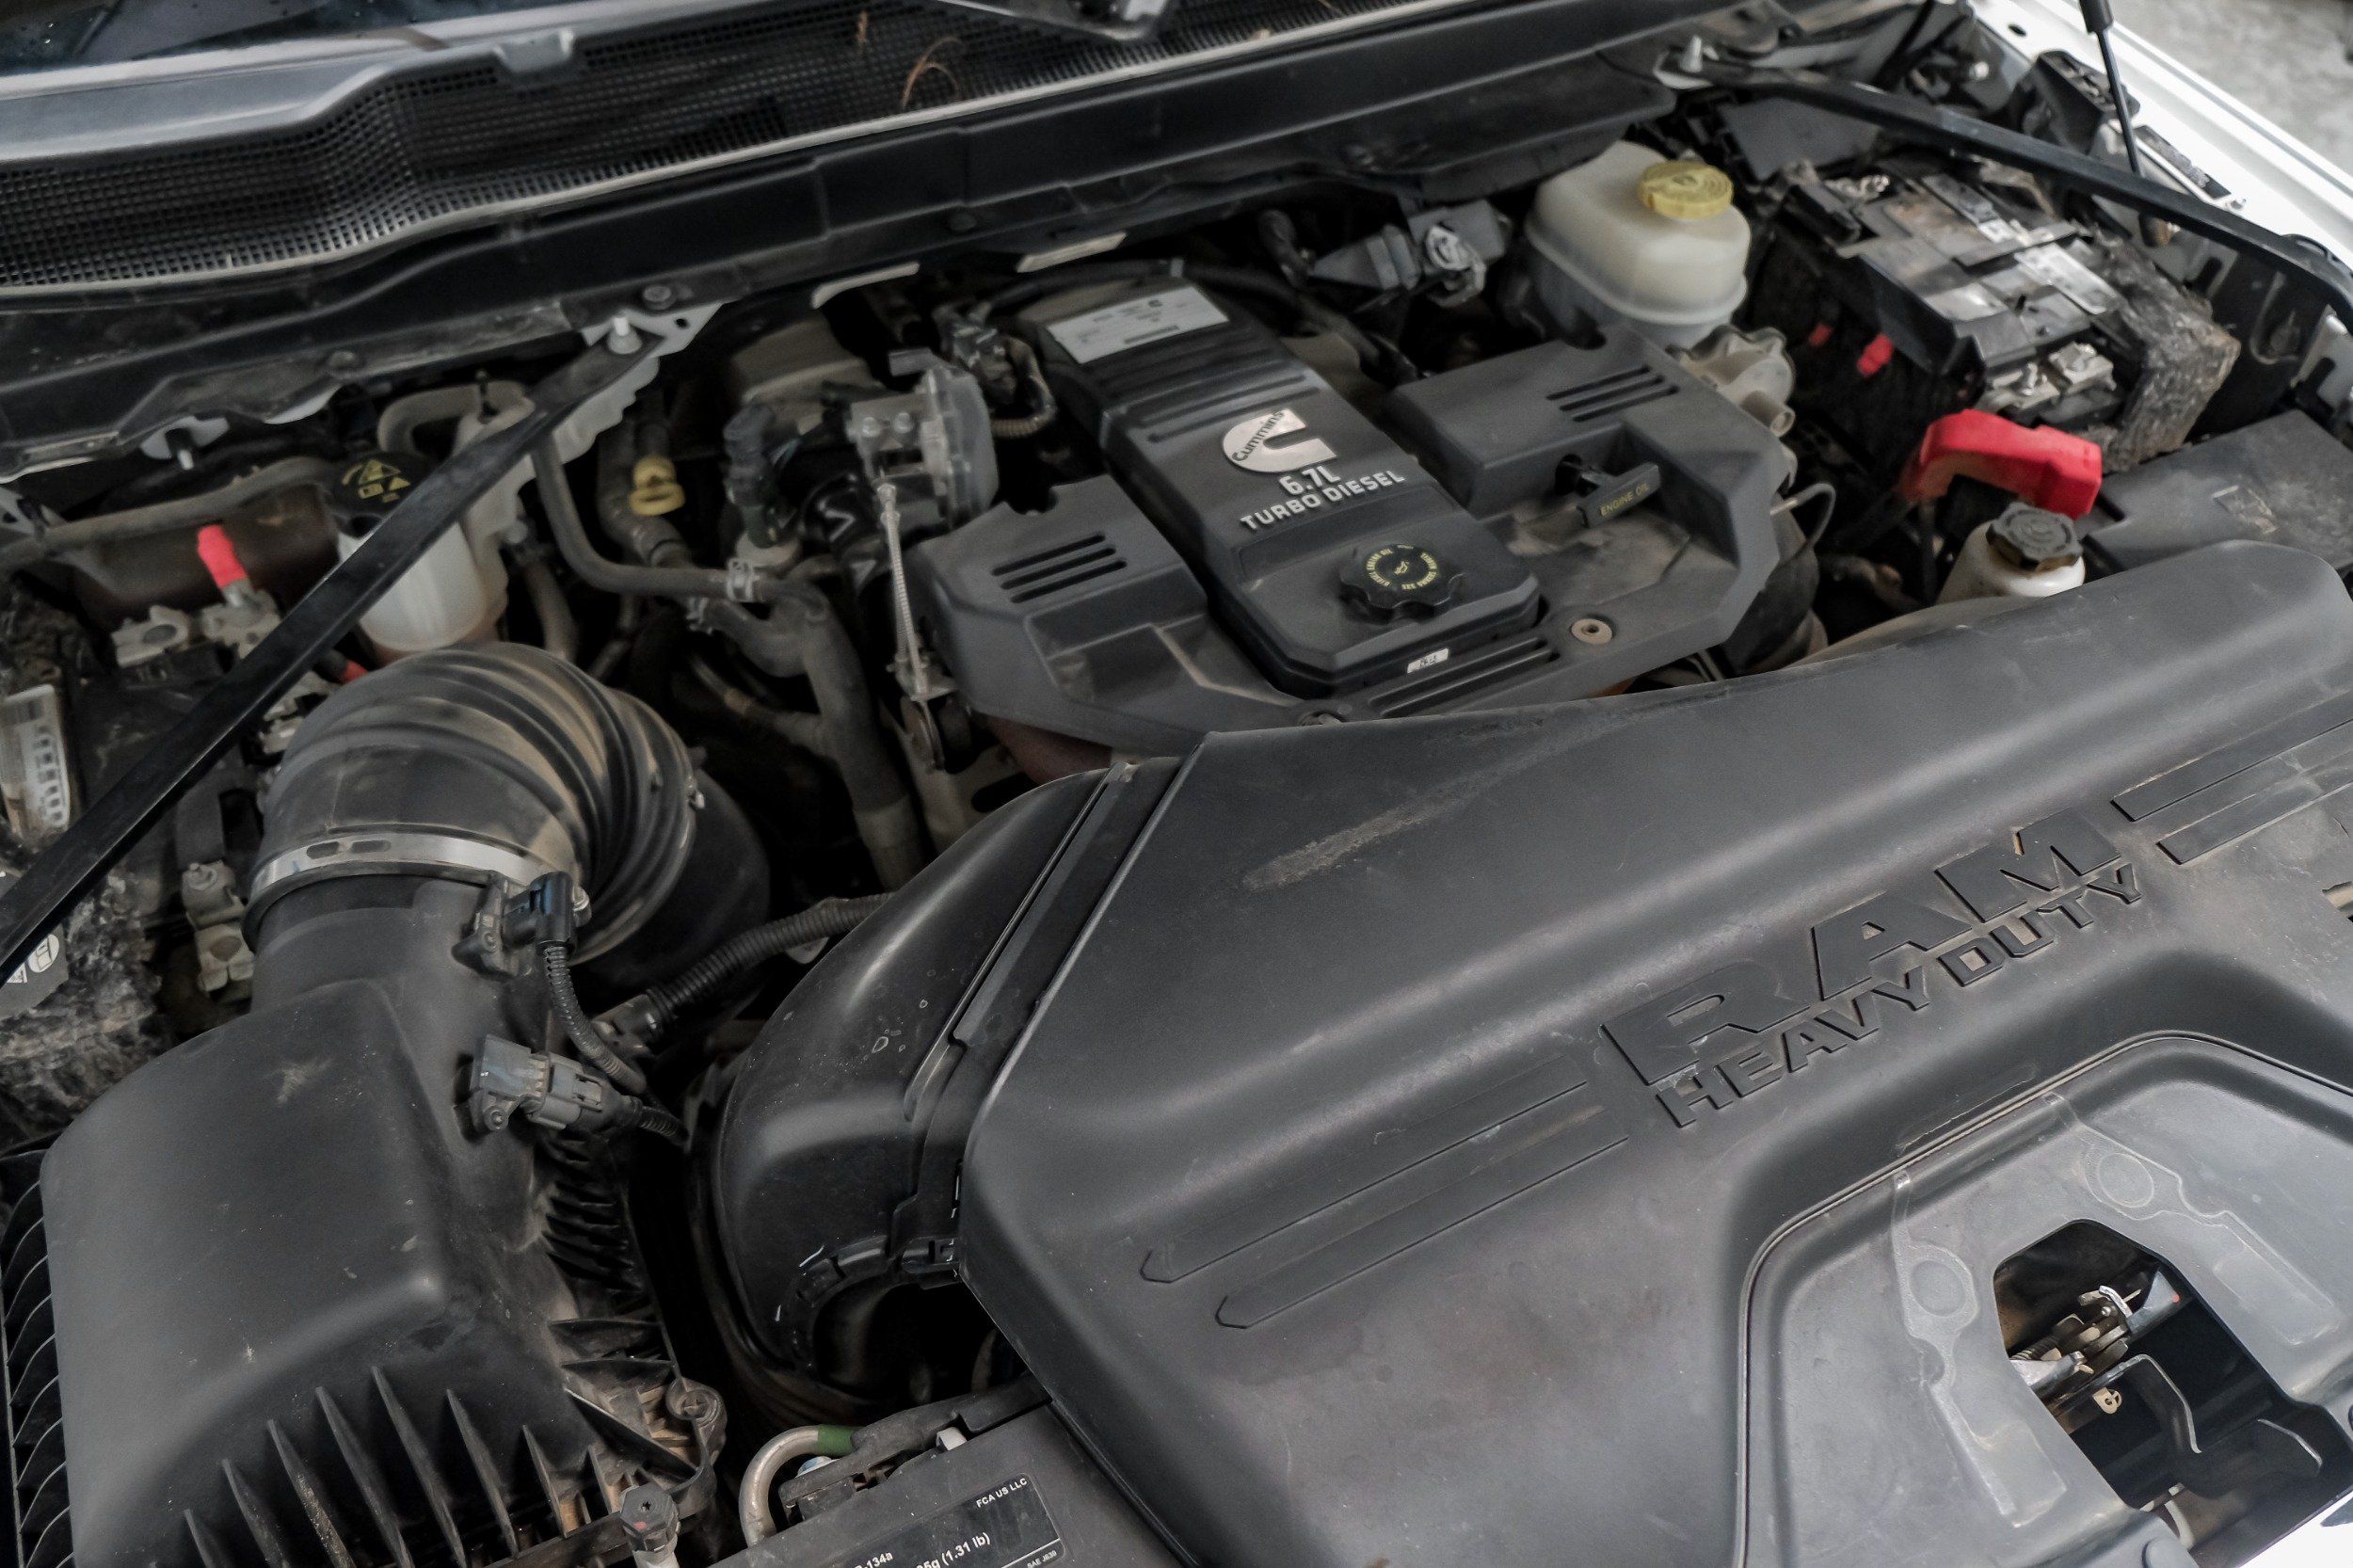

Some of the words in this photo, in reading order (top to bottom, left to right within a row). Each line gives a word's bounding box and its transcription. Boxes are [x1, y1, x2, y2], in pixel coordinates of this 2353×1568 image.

[1231, 411, 1285, 461] Cummins
[1241, 494, 1321, 530] TURBO
[1321, 470, 1405, 502] DIESEL
[1278, 466, 1340, 495] 6.7L
[1600, 489, 1634, 517] ENGINE
[1600, 808, 2121, 1085] RAM
[1656, 966, 1930, 1128] HEAVY
[1938, 863, 2142, 987] DUTY
[976, 1494, 996, 1508] FCA
[995, 1486, 1009, 1497] US
[1009, 1478, 1028, 1491] LLC
[941, 1541, 971, 1566] (1.31
[971, 1531, 991, 1548] lb)
